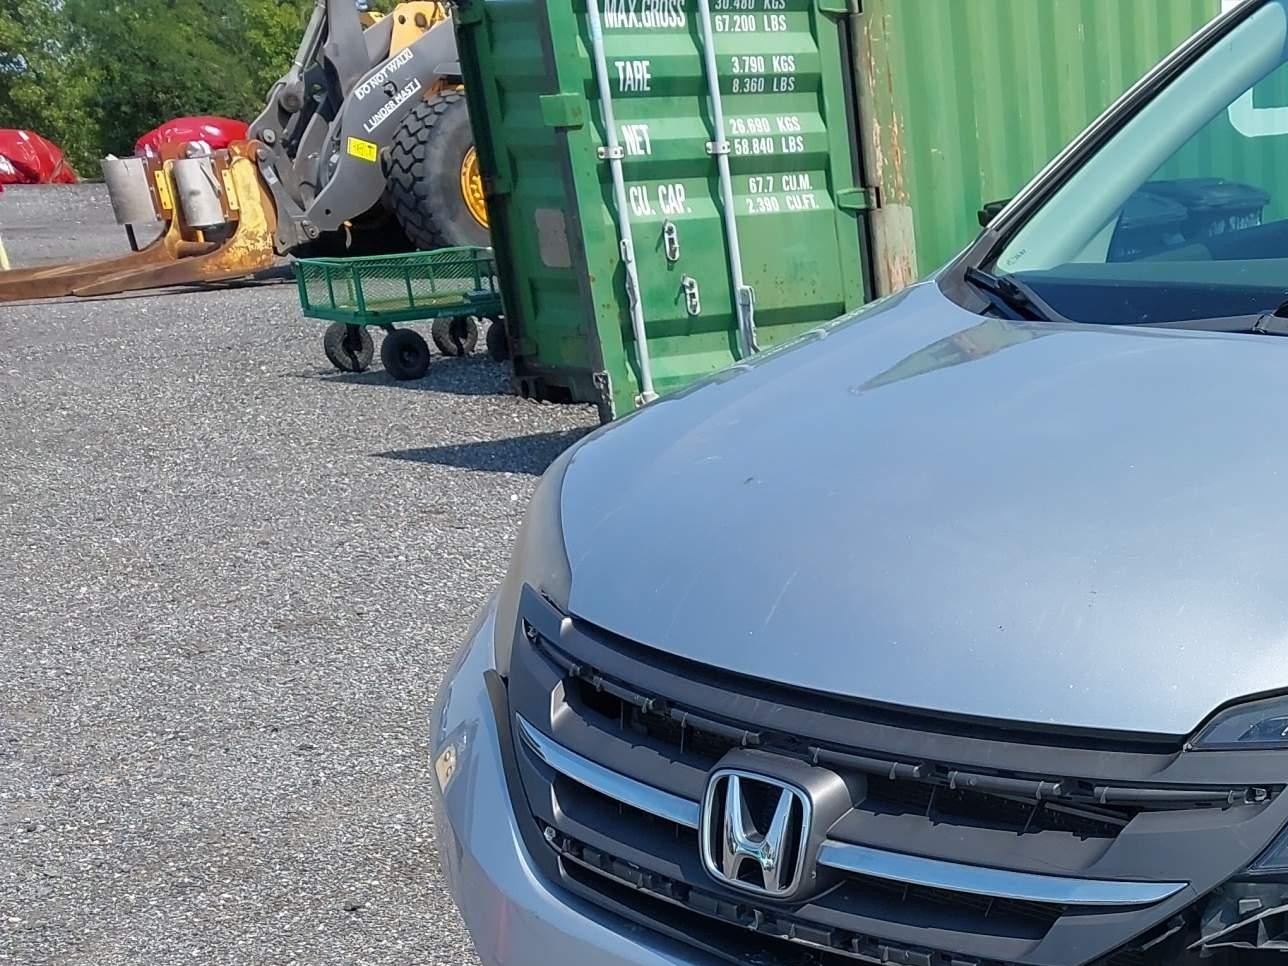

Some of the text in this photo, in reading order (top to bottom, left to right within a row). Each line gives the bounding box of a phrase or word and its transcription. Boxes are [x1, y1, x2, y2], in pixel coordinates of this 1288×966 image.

[604, 0, 686, 29] MAX.GROSS
[715, 14, 787, 32] 67.200 LBS
[615, 55, 796, 92] TARE 3.790 KGS
[732, 76, 795, 93] 8.360 LBS
[368, 99, 396, 125] UNDER
[621, 116, 801, 156] NET 26.690 KGS
[734, 136, 804, 155] 58.840 LBS
[629, 174, 813, 216] CU. CAP. 67.7 CU.M.
[746, 198, 780, 214] 2.390
